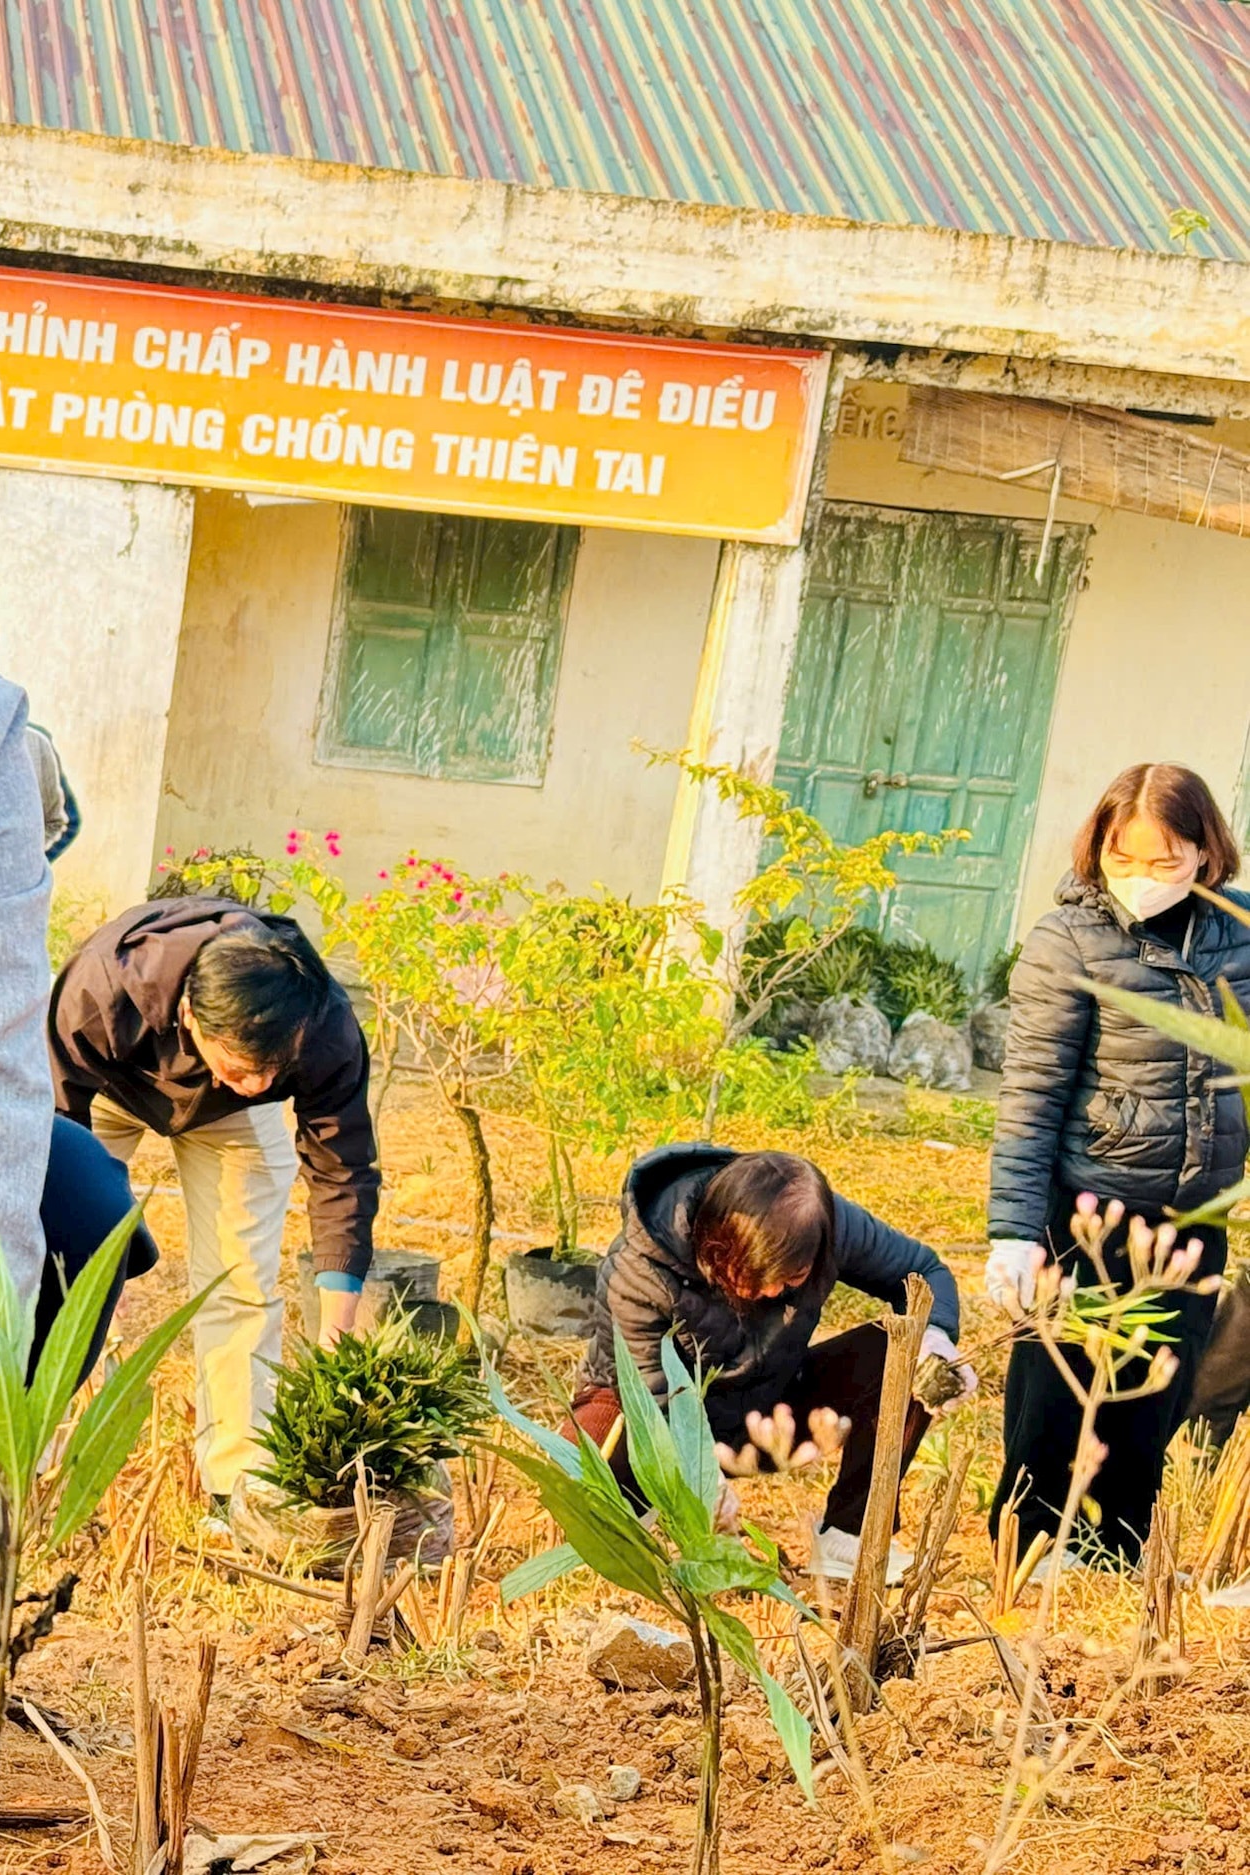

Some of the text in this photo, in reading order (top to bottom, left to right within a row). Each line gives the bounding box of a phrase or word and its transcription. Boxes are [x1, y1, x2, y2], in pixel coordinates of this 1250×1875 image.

[133, 322, 271, 379] CHẤP
[285, 339, 427, 397] HÀNH
[441, 358, 567, 417] LUẬT
[578, 369, 645, 419] ĐÊ
[659, 374, 776, 431] ĐIỀU
[50, 391, 225, 451] PHÒNG
[241, 409, 415, 470] CHỐNG
[432, 433, 577, 487] THIÊN
[594, 450, 665, 495] TAI
